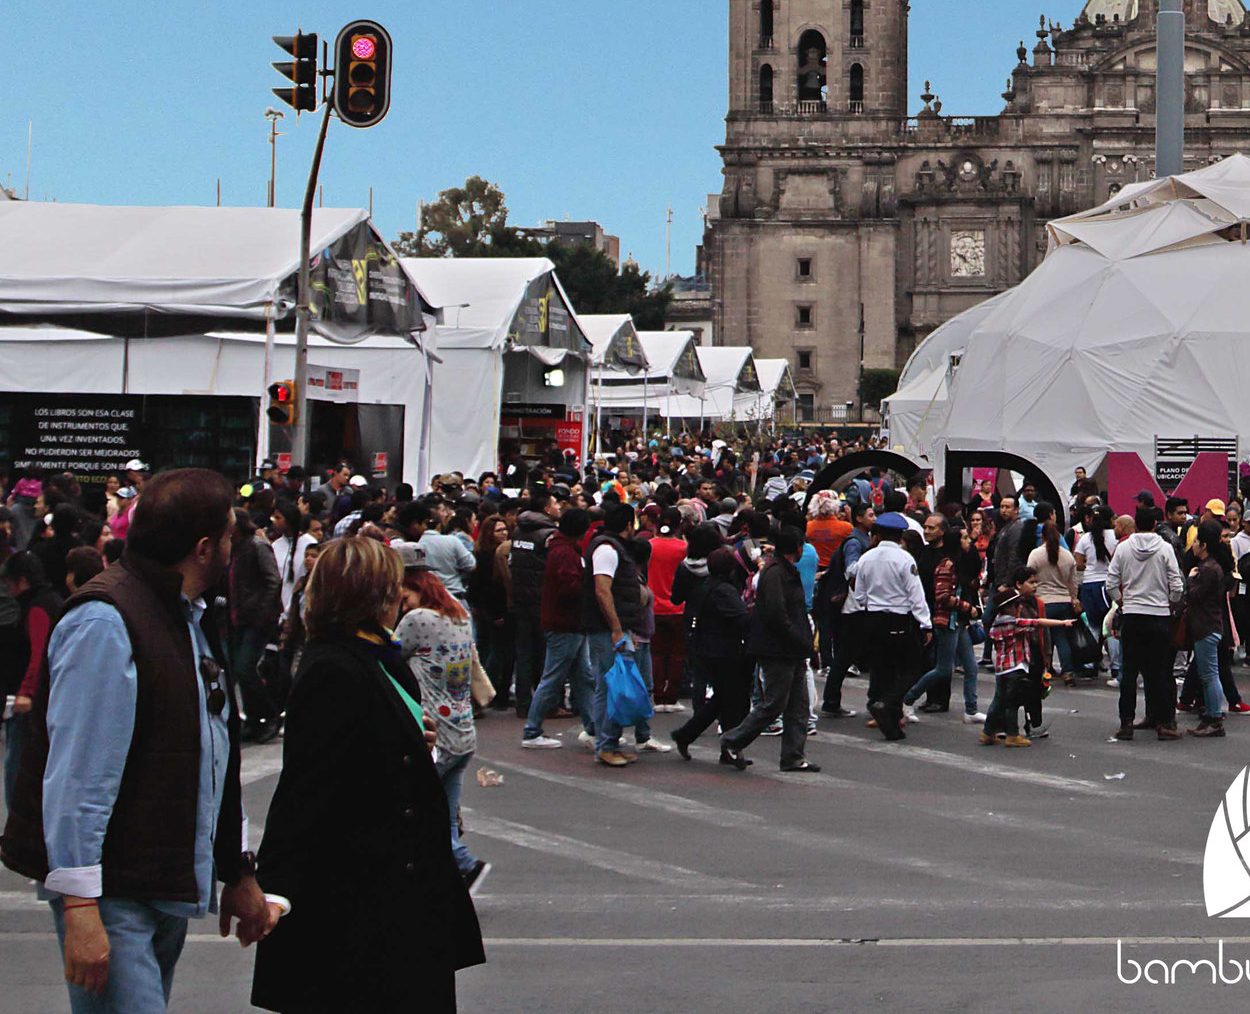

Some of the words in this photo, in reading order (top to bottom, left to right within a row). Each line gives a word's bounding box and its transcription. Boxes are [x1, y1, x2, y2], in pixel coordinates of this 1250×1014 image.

[34, 408, 49, 417] LOS
[50, 409, 76, 417] LIBROS
[77, 409, 94, 417] SON
[95, 410, 109, 418] ESA
[110, 410, 135, 418] CLASE
[38, 421, 49, 430] DE
[50, 422, 110, 431] INSTRUMENTOS
[40, 435, 57, 443] UNA
[59, 435, 73, 443] VEZ
[25, 448, 37, 456] NO
[38, 448, 77, 457] PUDIERON
[79, 449, 93, 457] SER
[94, 449, 140, 458] MEJORADOS
[68, 461, 100, 471] PORQUE
[100, 462, 117, 471] SON
